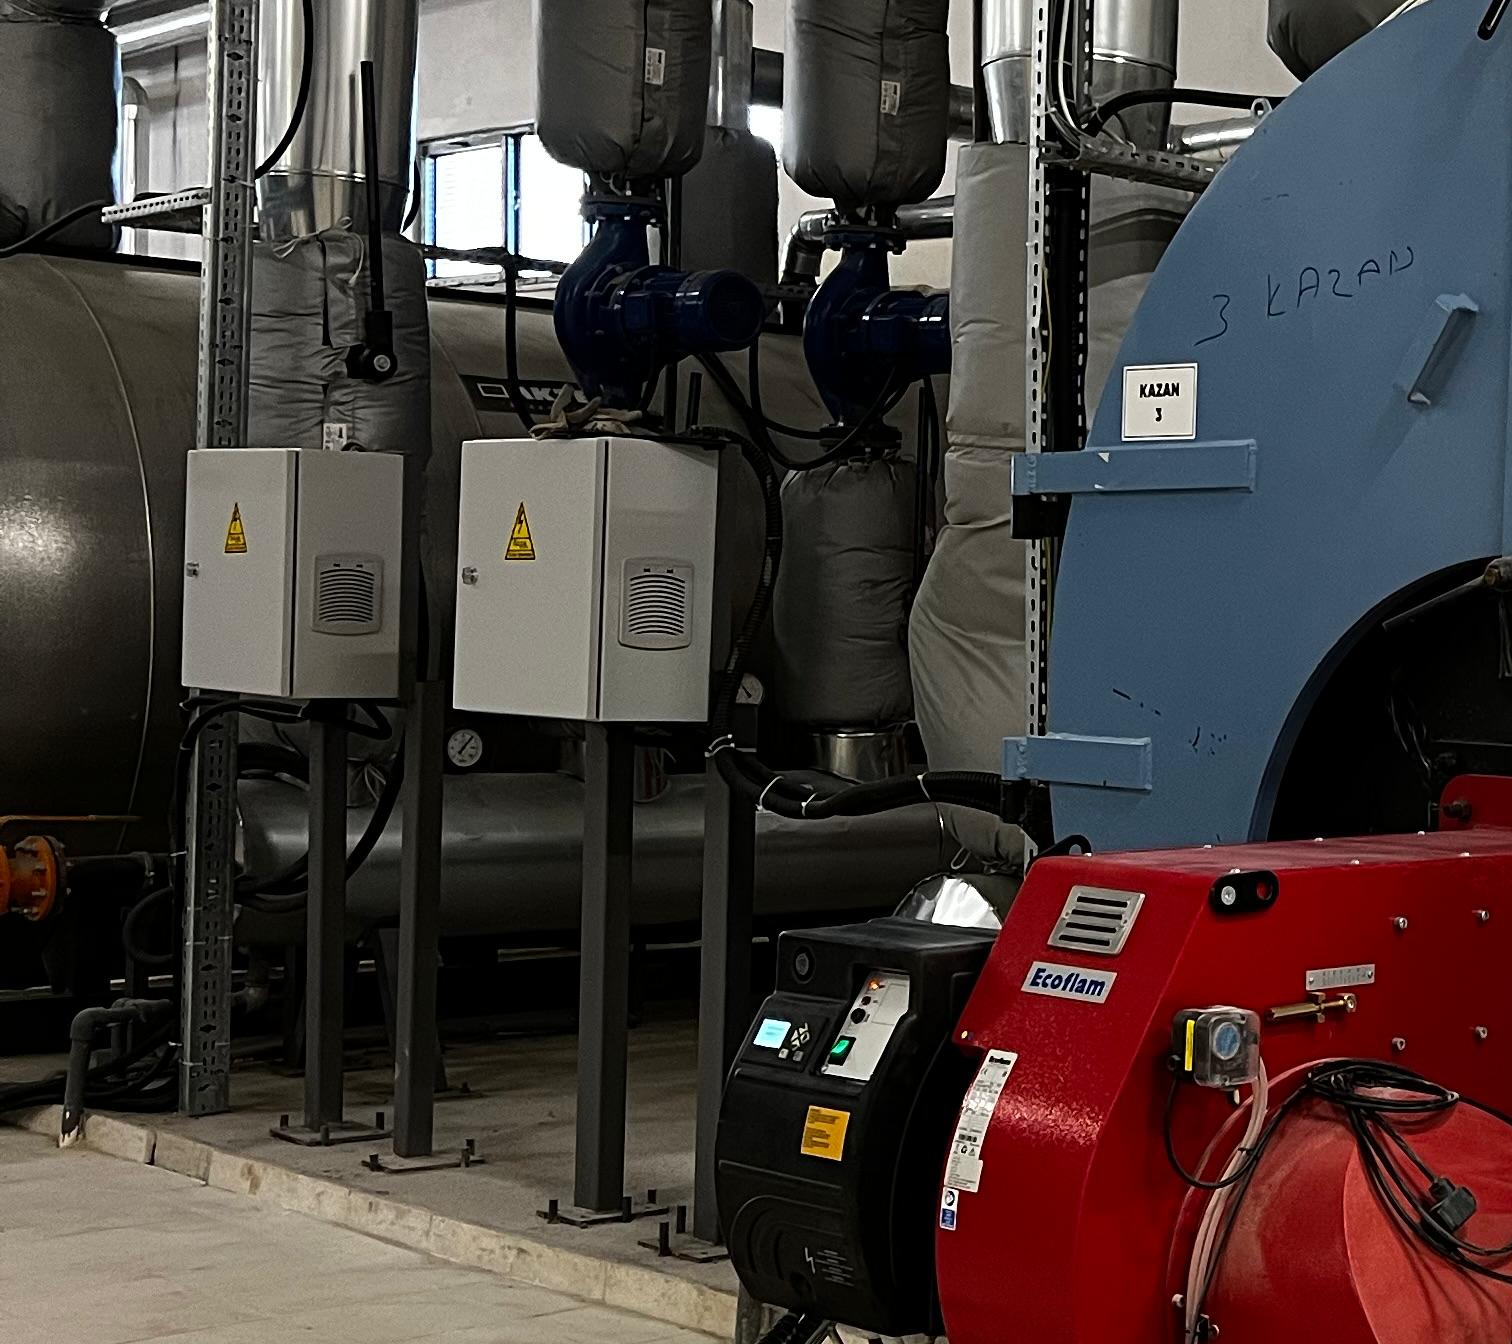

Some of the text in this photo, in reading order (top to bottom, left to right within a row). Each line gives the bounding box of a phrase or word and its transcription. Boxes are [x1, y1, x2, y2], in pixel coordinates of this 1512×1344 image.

[1194, 294, 1230, 346] 3
[1139, 382, 1180, 398] KAZAN
[1030, 967, 1106, 997] Ecoflam
